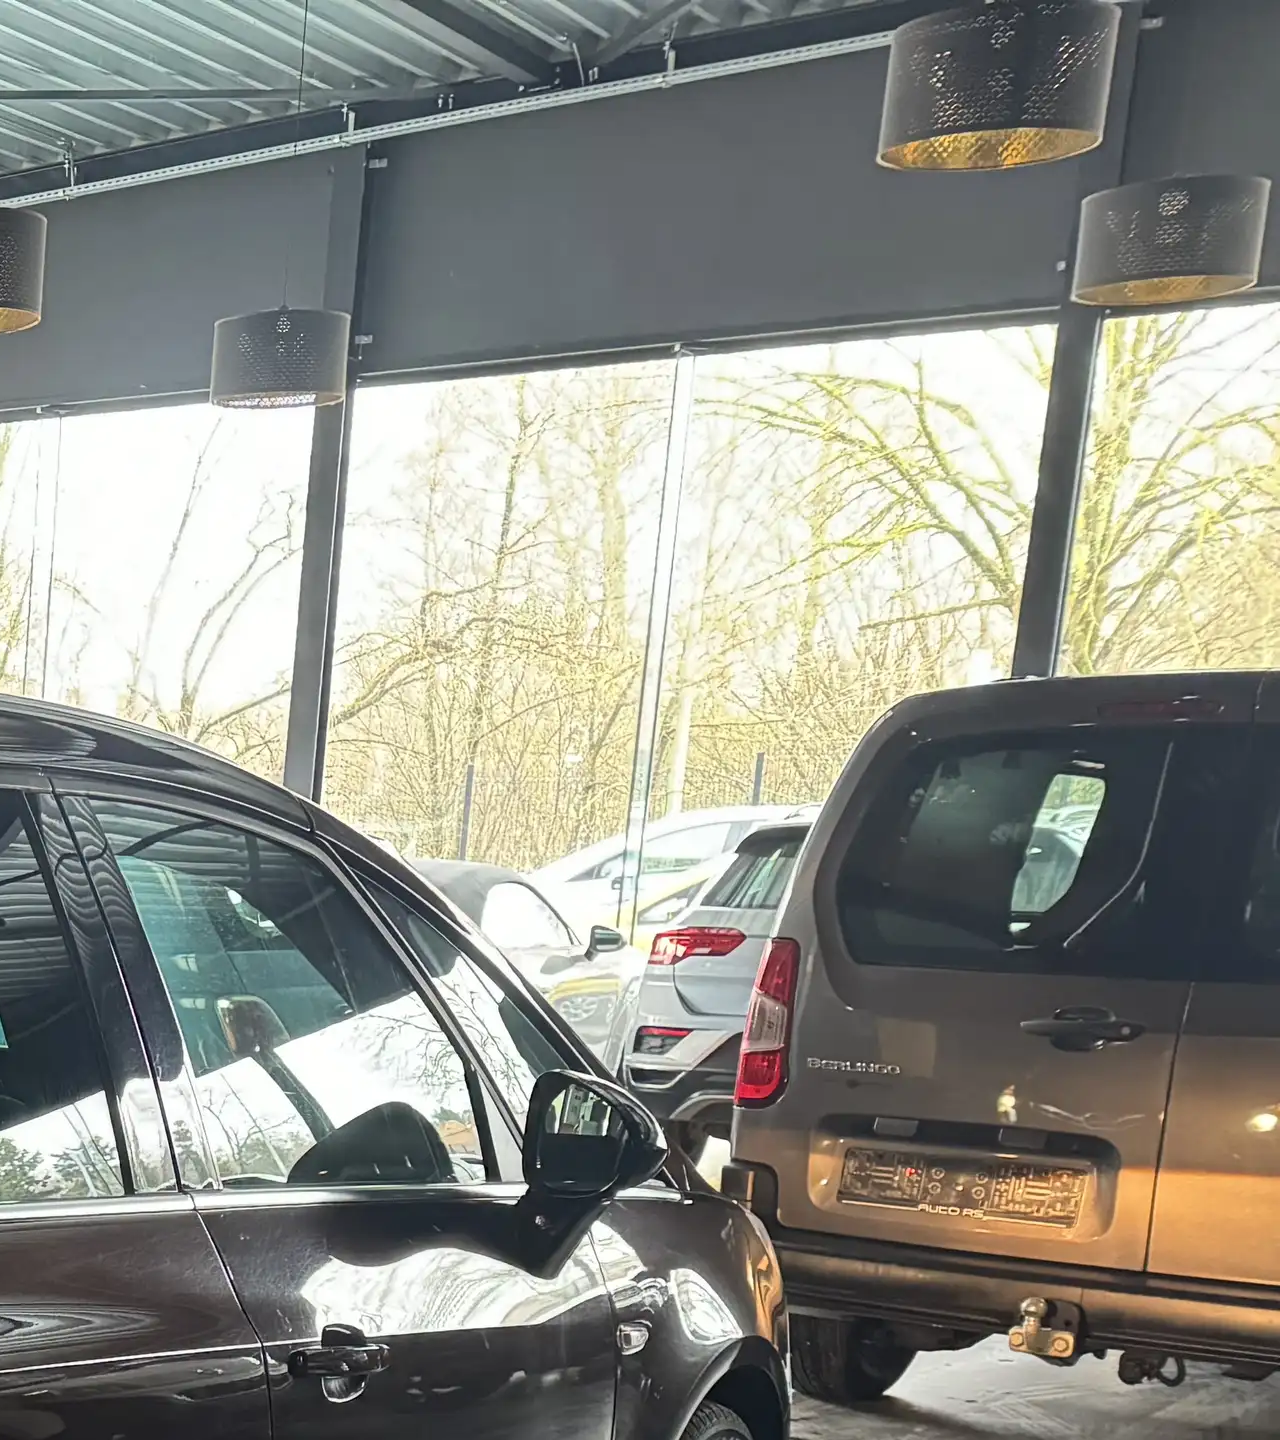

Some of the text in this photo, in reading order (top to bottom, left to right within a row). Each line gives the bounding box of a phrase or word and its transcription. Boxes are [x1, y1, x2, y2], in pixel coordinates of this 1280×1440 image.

[807, 1057, 901, 1075] BERLINGO
[917, 1203, 985, 1219] AUTO RS
